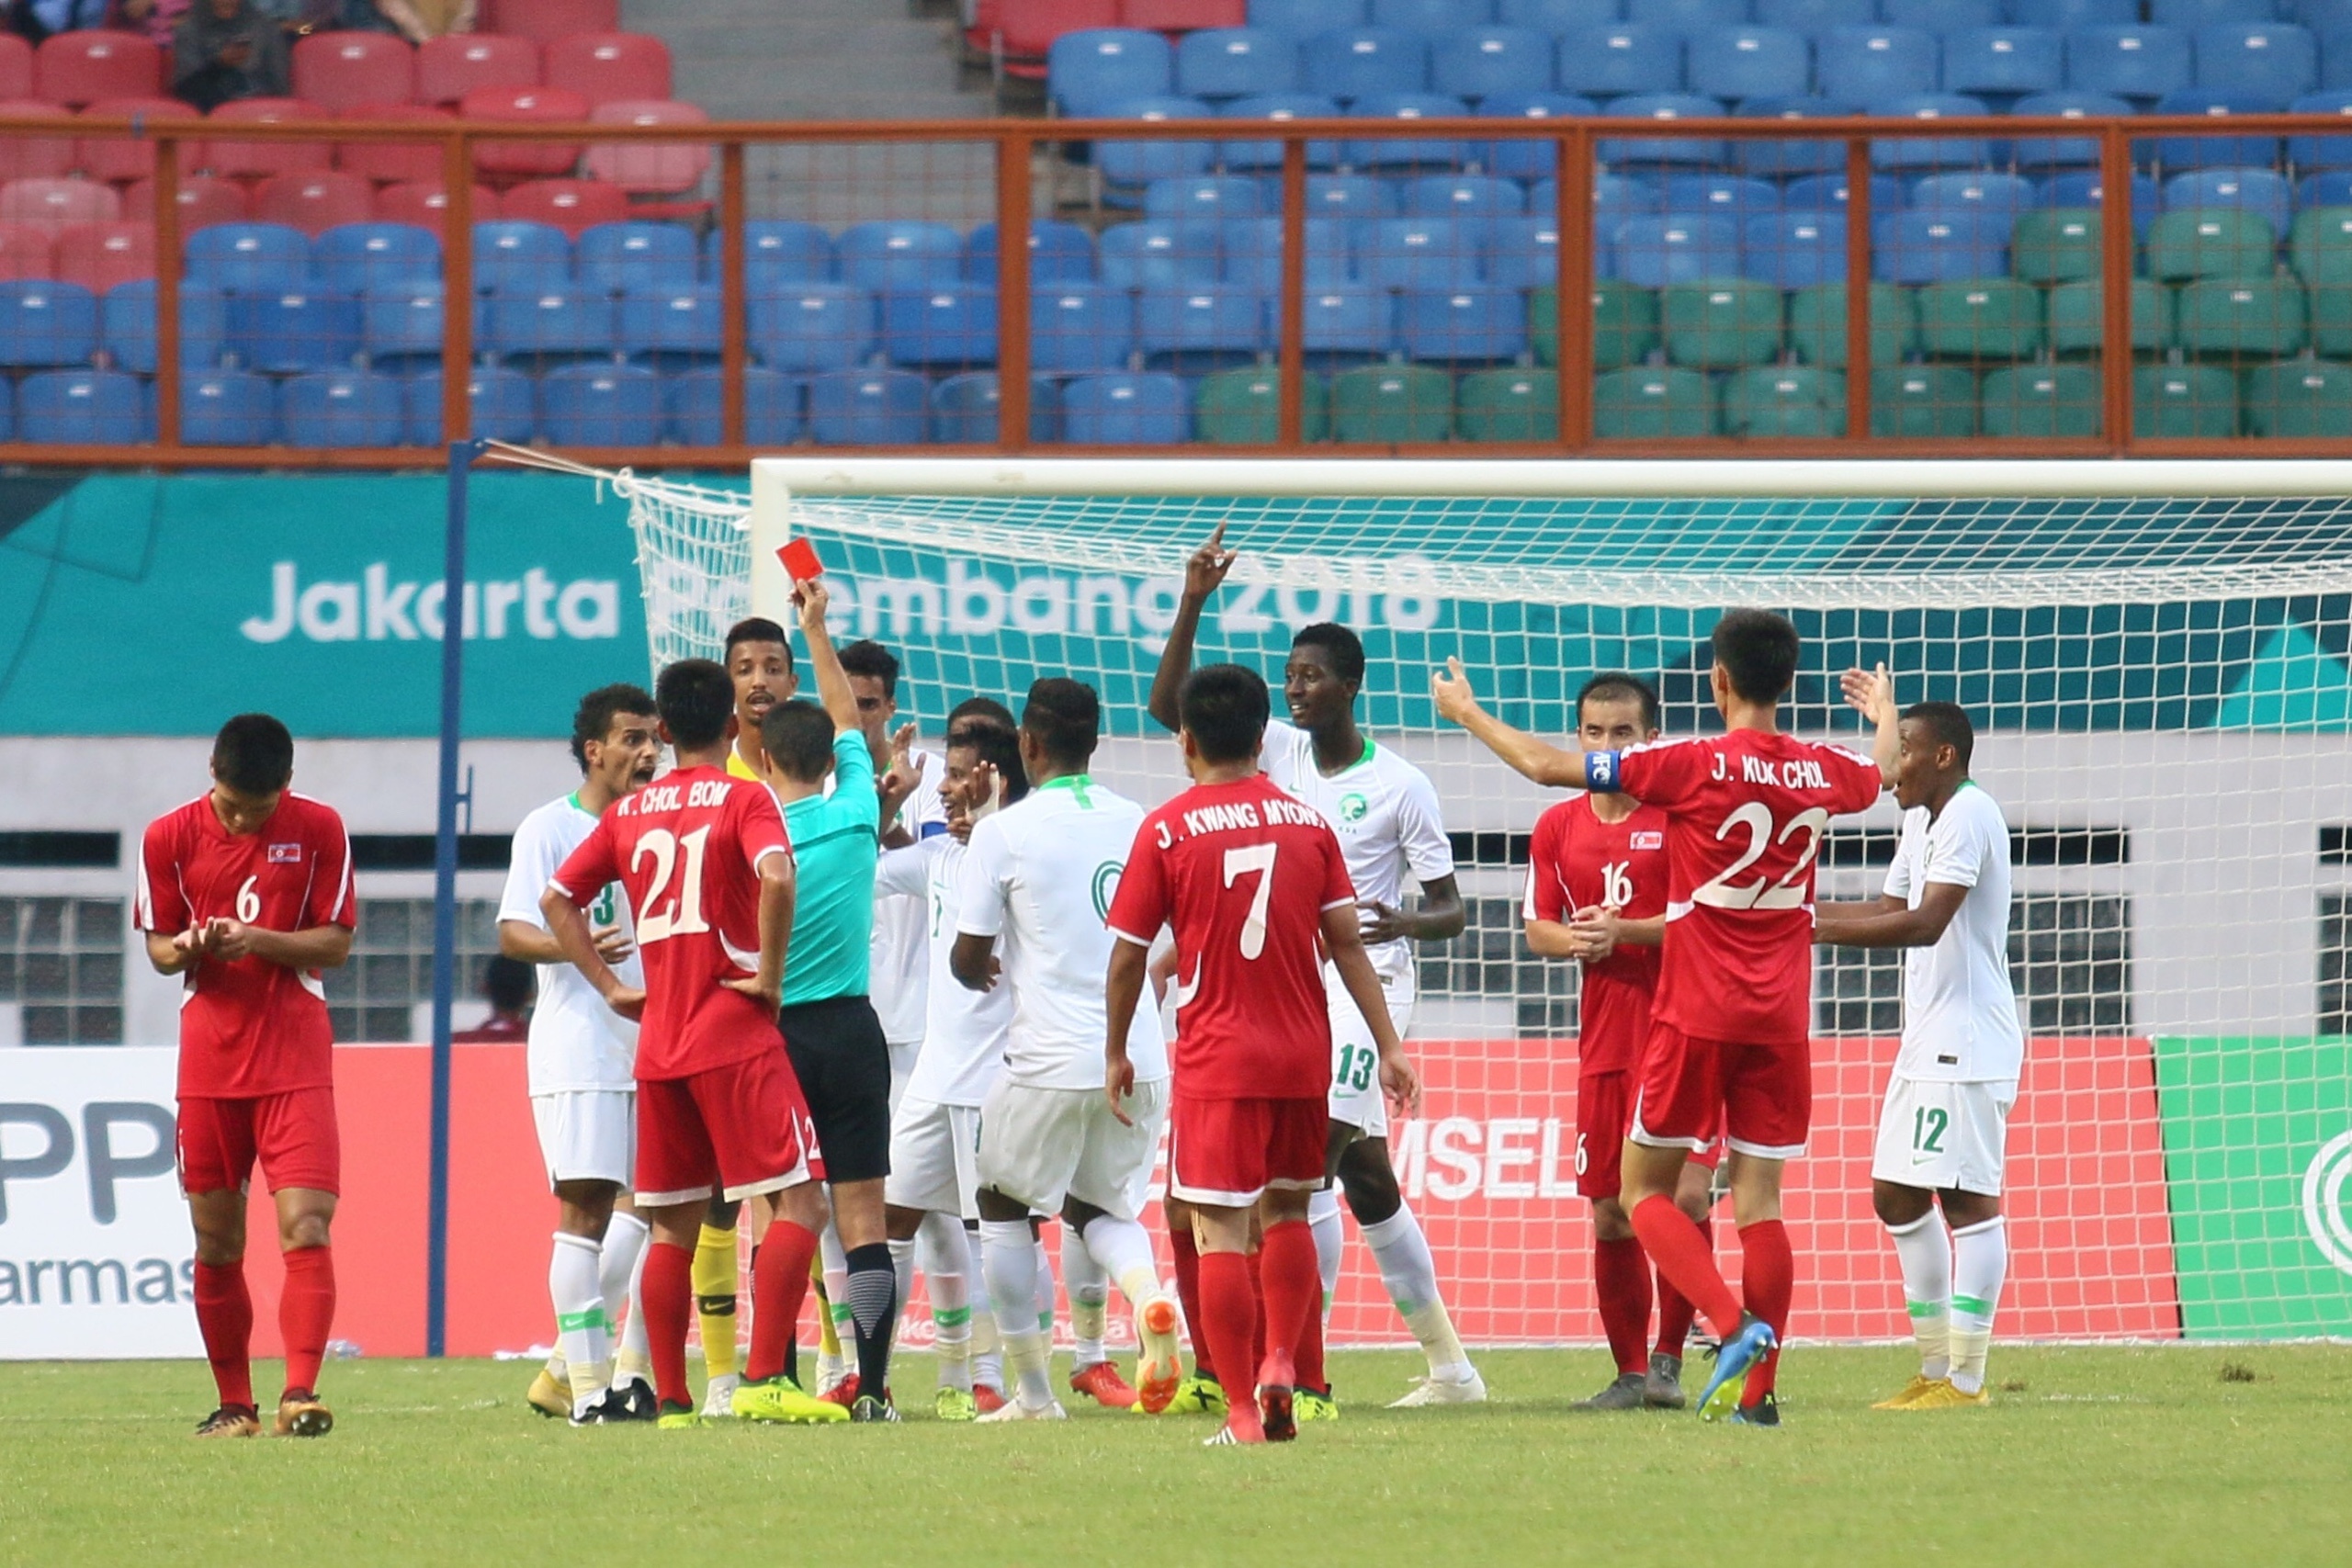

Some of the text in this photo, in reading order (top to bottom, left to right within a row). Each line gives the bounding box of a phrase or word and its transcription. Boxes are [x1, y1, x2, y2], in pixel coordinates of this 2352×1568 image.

[240, 554, 1441, 655] Jakarta Paembang 2018
[1782, 760, 1832, 789] CHOL
[640, 785, 683, 815] CHOL
[1183, 802, 1260, 838] KWANG
[1691, 801, 1828, 909] 22
[235, 874, 261, 924] 6
[630, 823, 712, 946] 21
[1223, 841, 1278, 961] 7
[1600, 860, 1634, 908] 16
[1336, 1043, 1375, 1092] 13
[1913, 1105, 1949, 1154] 12
